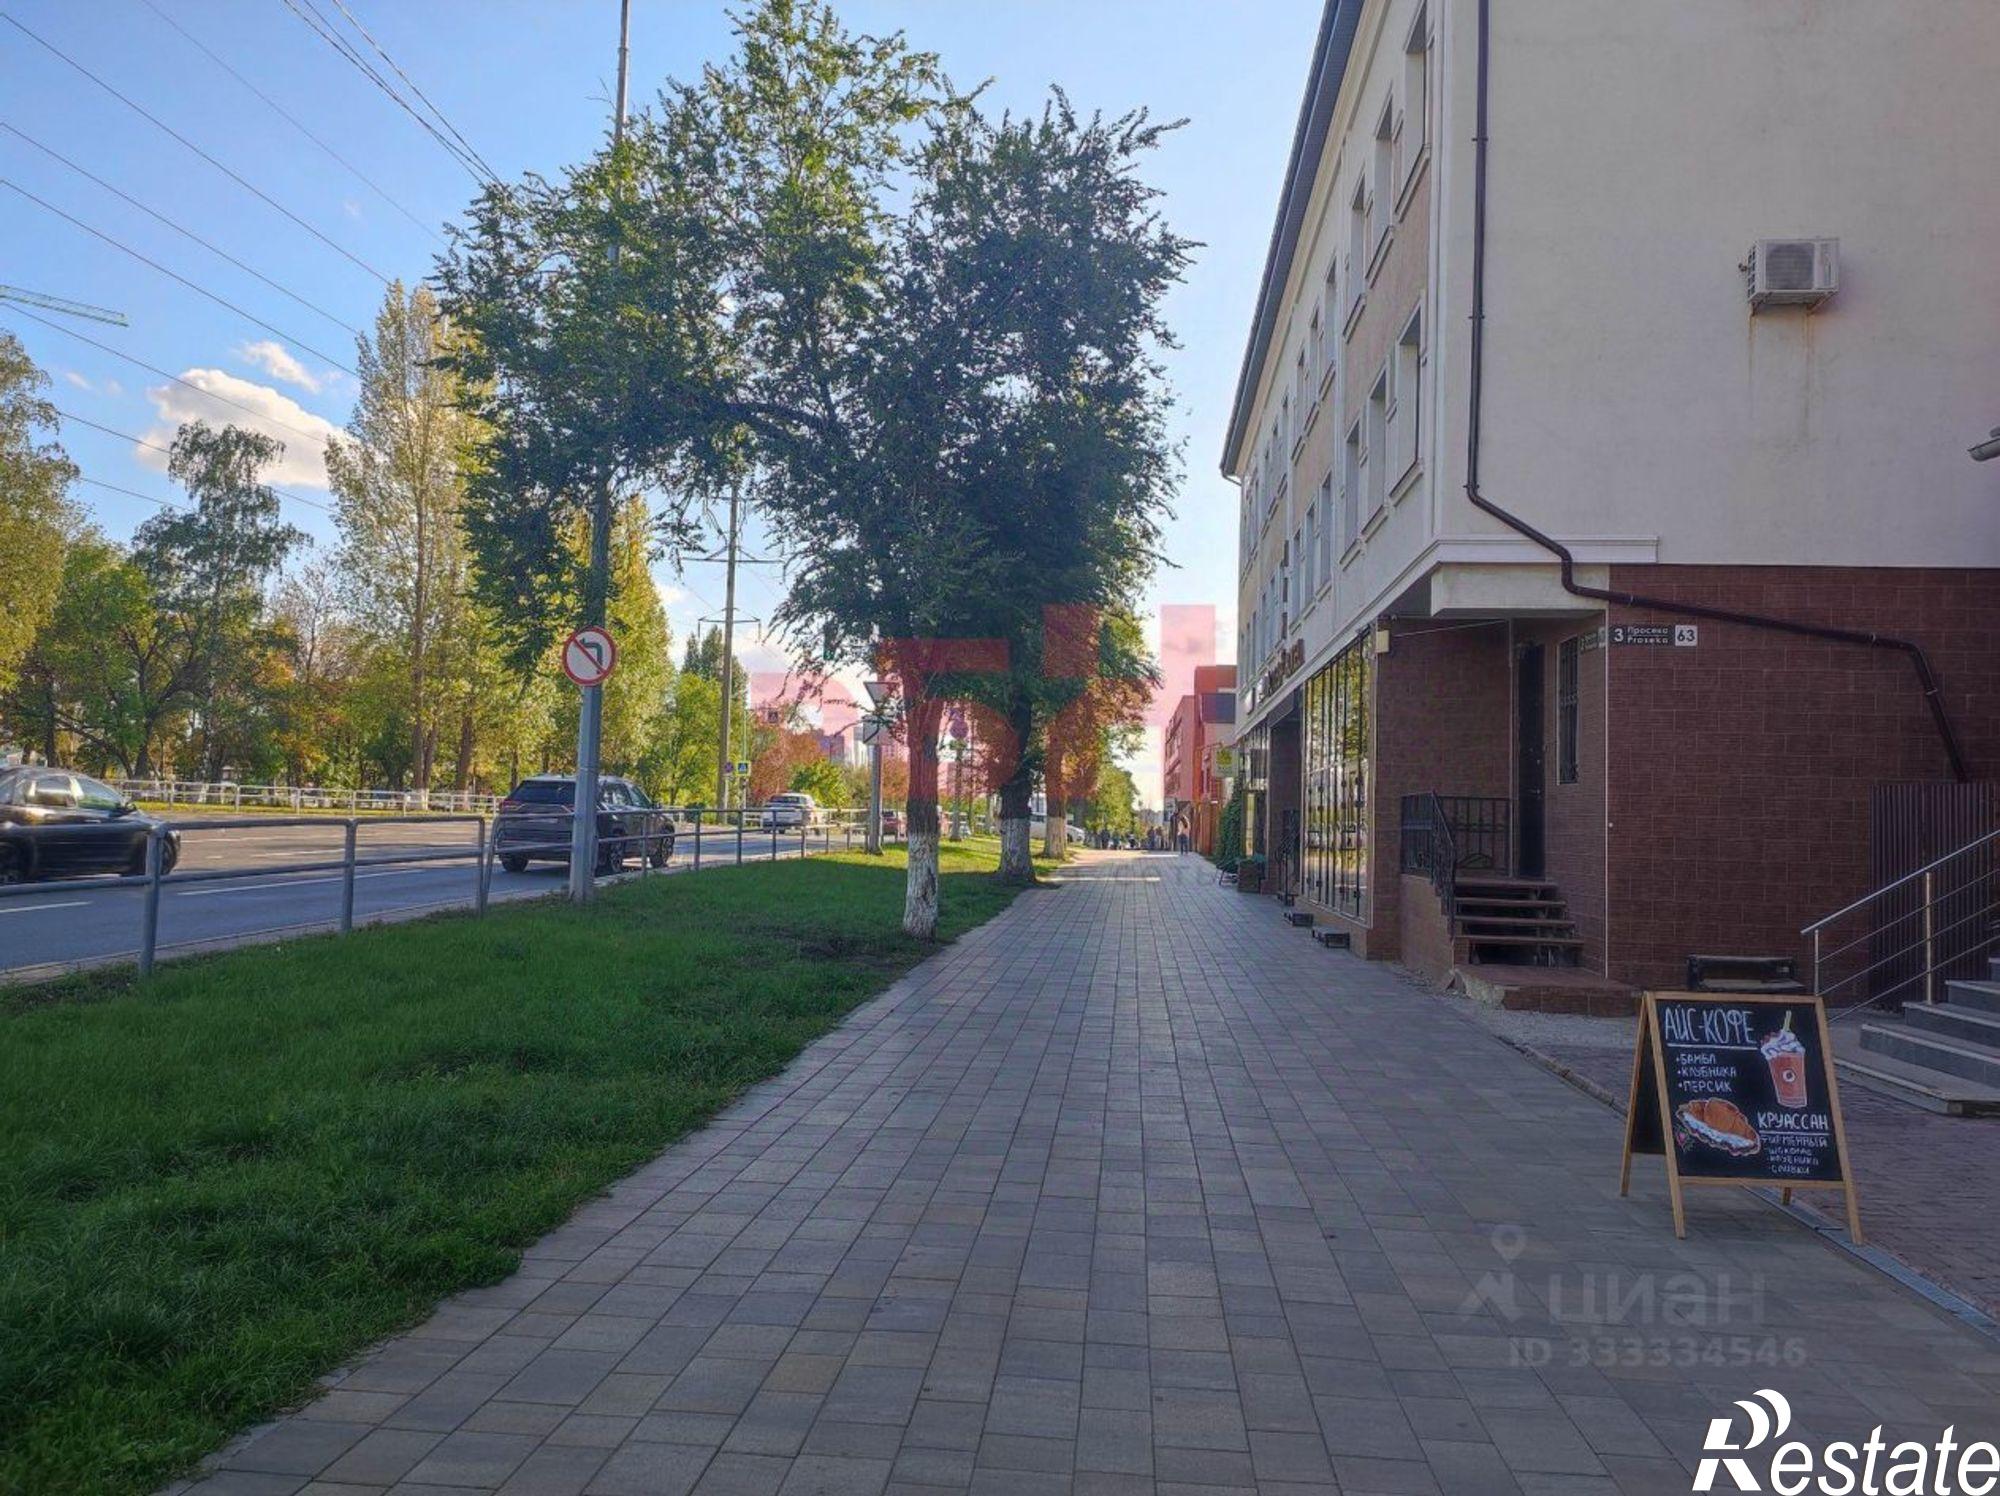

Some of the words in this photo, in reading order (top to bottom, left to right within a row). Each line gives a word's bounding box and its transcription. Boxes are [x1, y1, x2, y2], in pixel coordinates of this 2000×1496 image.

[1614, 628, 1624, 642] 3
[1627, 626, 1669, 635] Просека
[1677, 629, 1695, 642] 63
[1665, 1004, 1758, 1044] АЙС-КОФЕ
[1681, 1066, 1737, 1078] КЛУБНИКА
[1683, 1080, 1732, 1092] ПЕРСИК
[1757, 1111, 1828, 1130] КРУАССАН
